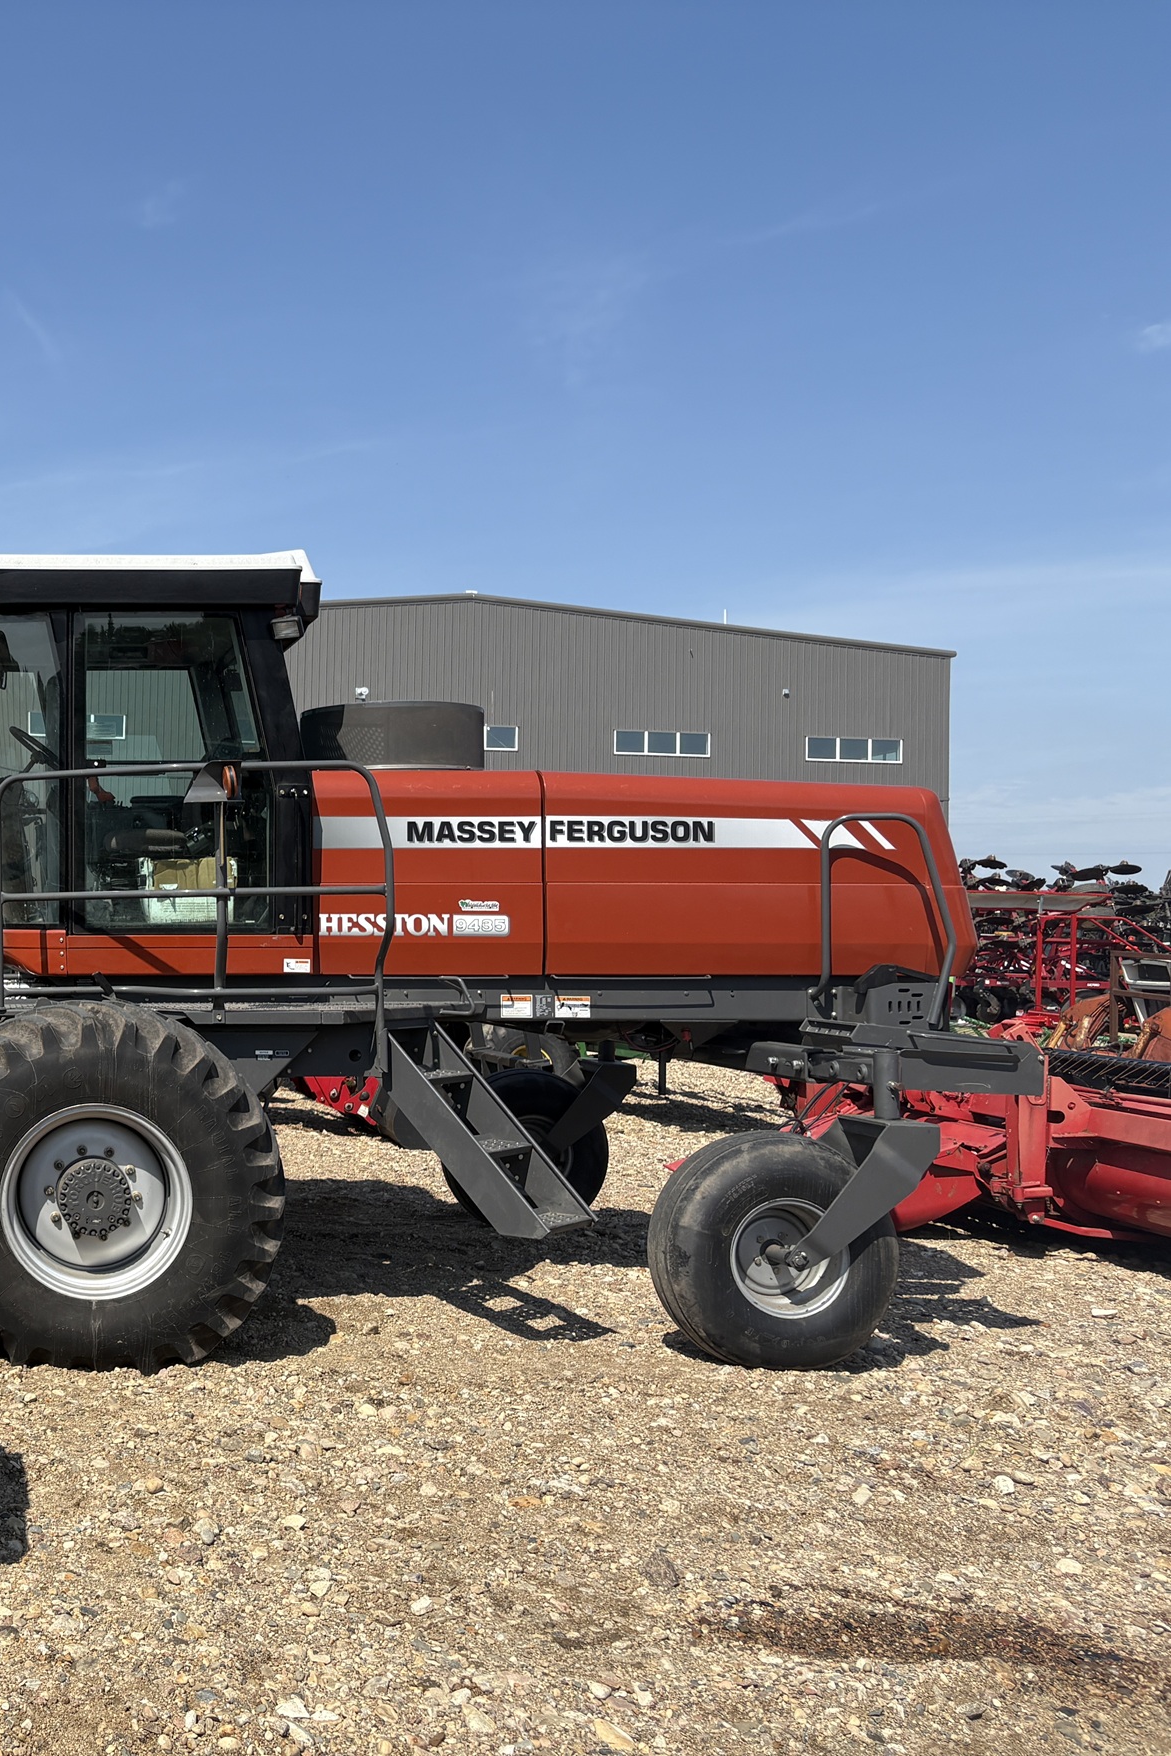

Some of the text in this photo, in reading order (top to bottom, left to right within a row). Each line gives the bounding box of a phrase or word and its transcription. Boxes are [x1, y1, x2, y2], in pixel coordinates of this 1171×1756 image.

[407, 819, 716, 844] MASSEY FERGUSON
[319, 913, 450, 937] HESSTON
[455, 918, 507, 933] 9435
